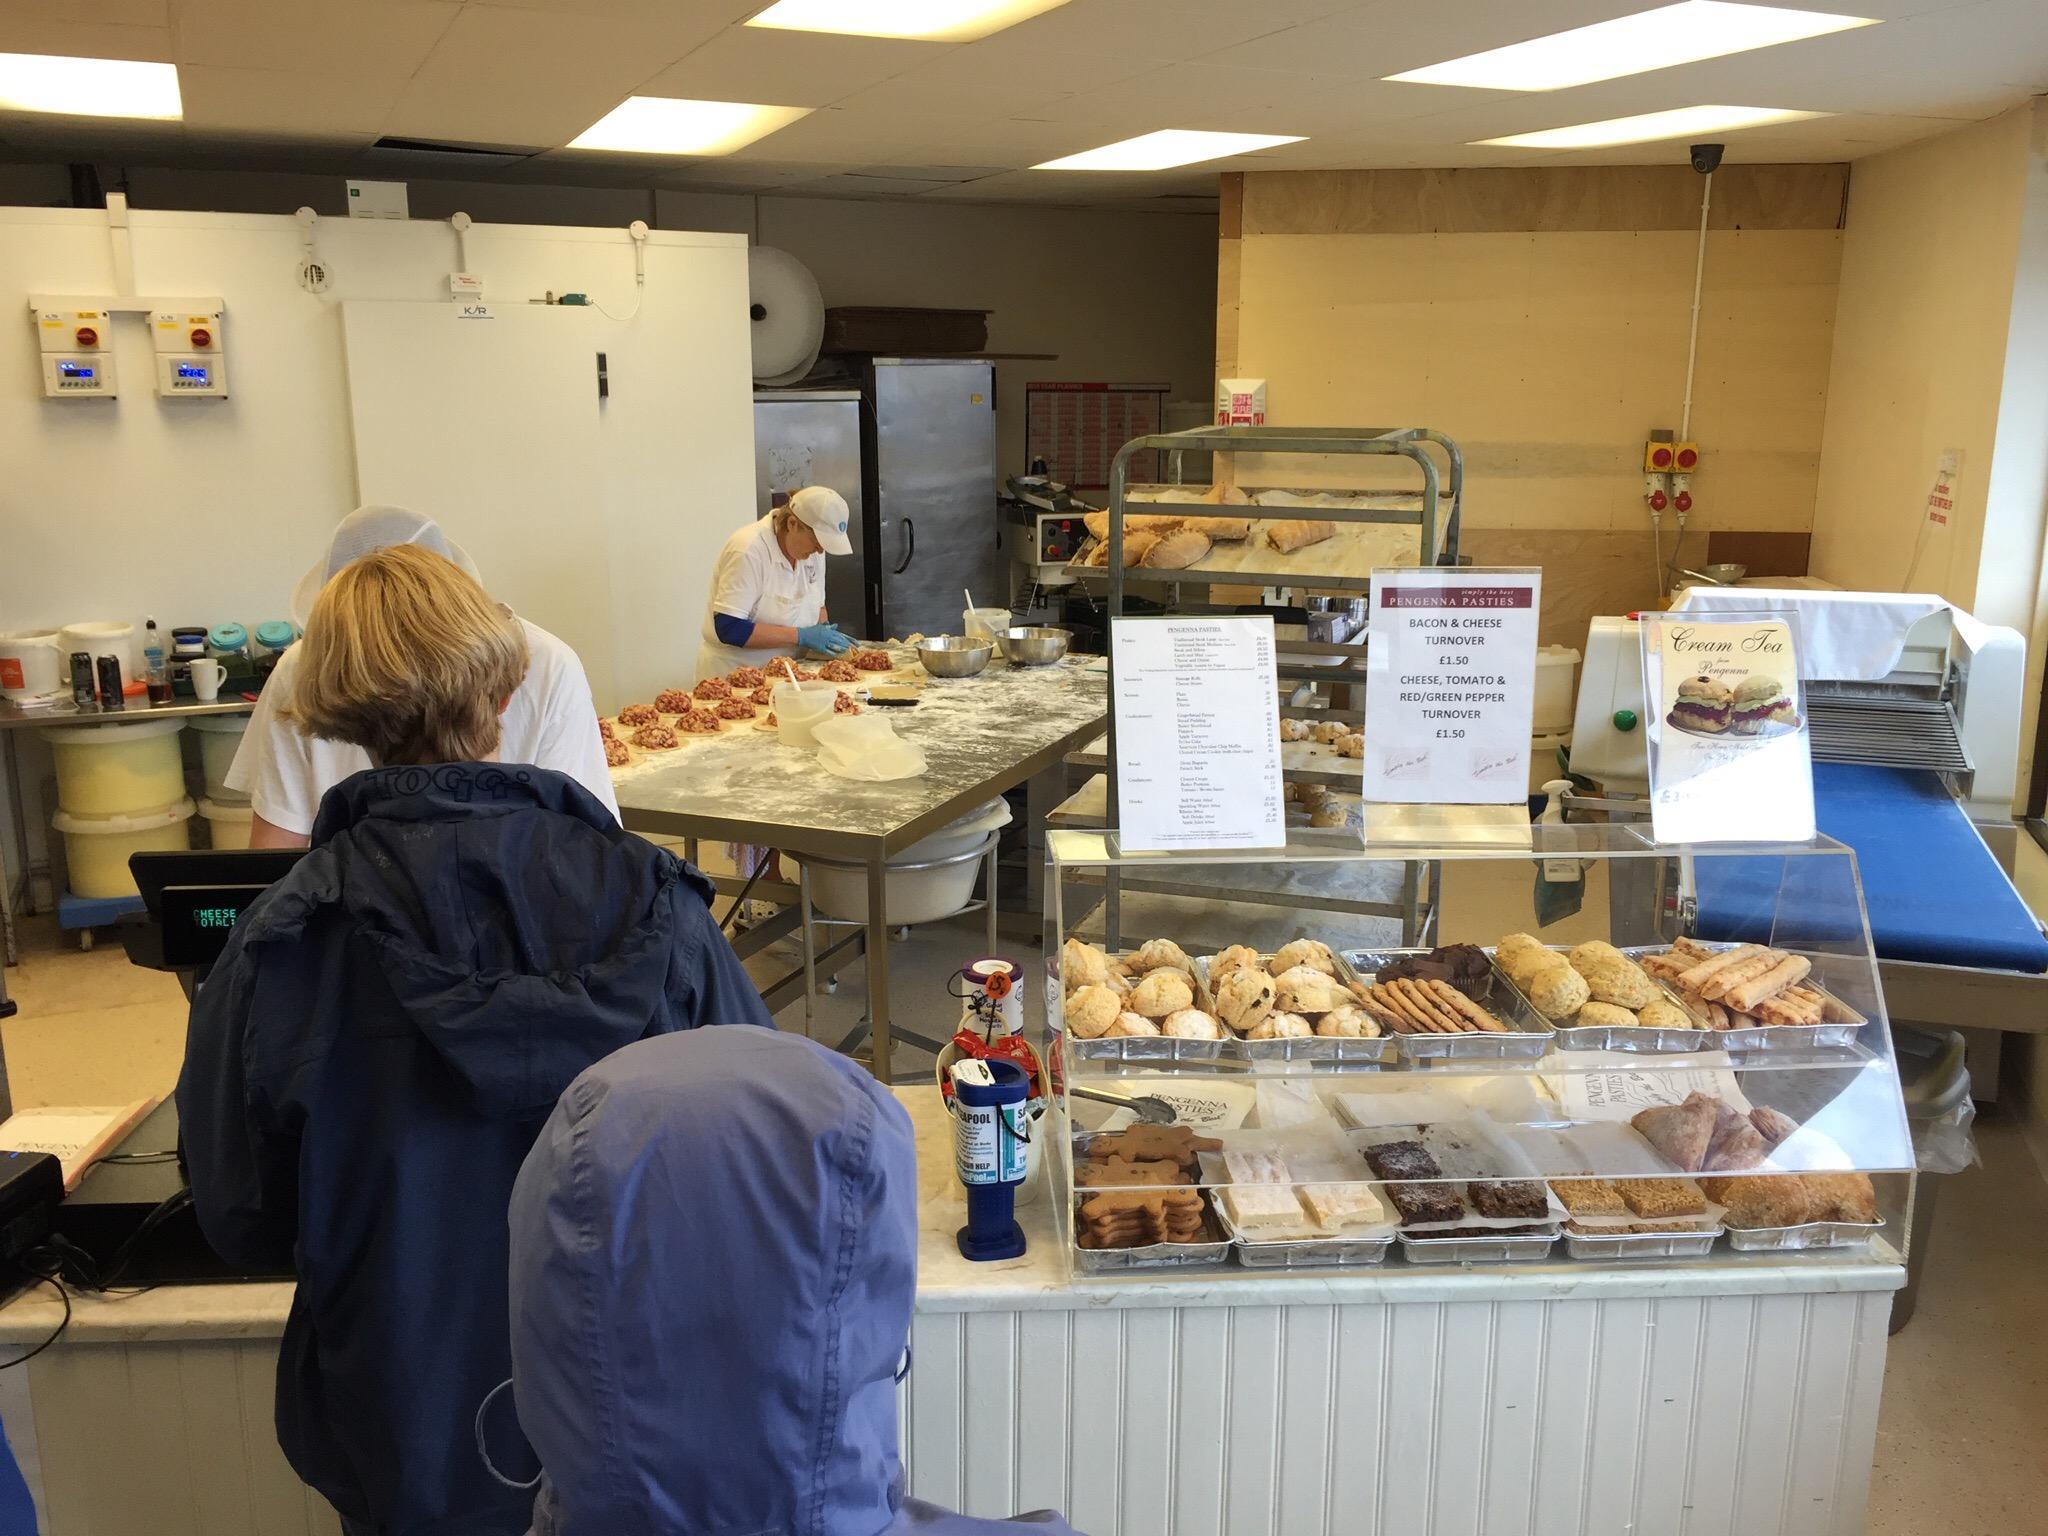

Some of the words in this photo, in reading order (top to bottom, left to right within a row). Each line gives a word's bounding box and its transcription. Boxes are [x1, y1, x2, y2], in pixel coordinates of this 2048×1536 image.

[1461, 588, 1484, 596] simply
[1389, 597, 1457, 607] PENGENNA
[1462, 597, 1515, 607] PASTIES
[1409, 618, 1448, 628] BACON
[1450, 618, 1459, 628] &
[1462, 618, 1502, 628] CHEESE
[1425, 636, 1485, 646] TURNOVER
[1671, 626, 1733, 652] Cream
[1741, 629, 1783, 654] Tea
[1439, 655, 1469, 665] £1.50
[1697, 660, 1749, 679] Pengenna
[1400, 675, 1443, 686] CHEESE,
[1445, 675, 1494, 685] TOMATO
[1496, 675, 1506, 685] &
[1400, 692, 1462, 703] RED/GREEN
[1465, 692, 1505, 702] PEPPER
[1422, 709, 1481, 719] TURNOVER
[1436, 729, 1465, 739] £1.50
[193, 909, 237, 919] CHEESE
[195, 918, 236, 928] TOTAL:
[1150, 1092, 1228, 1110] PENGENNA
